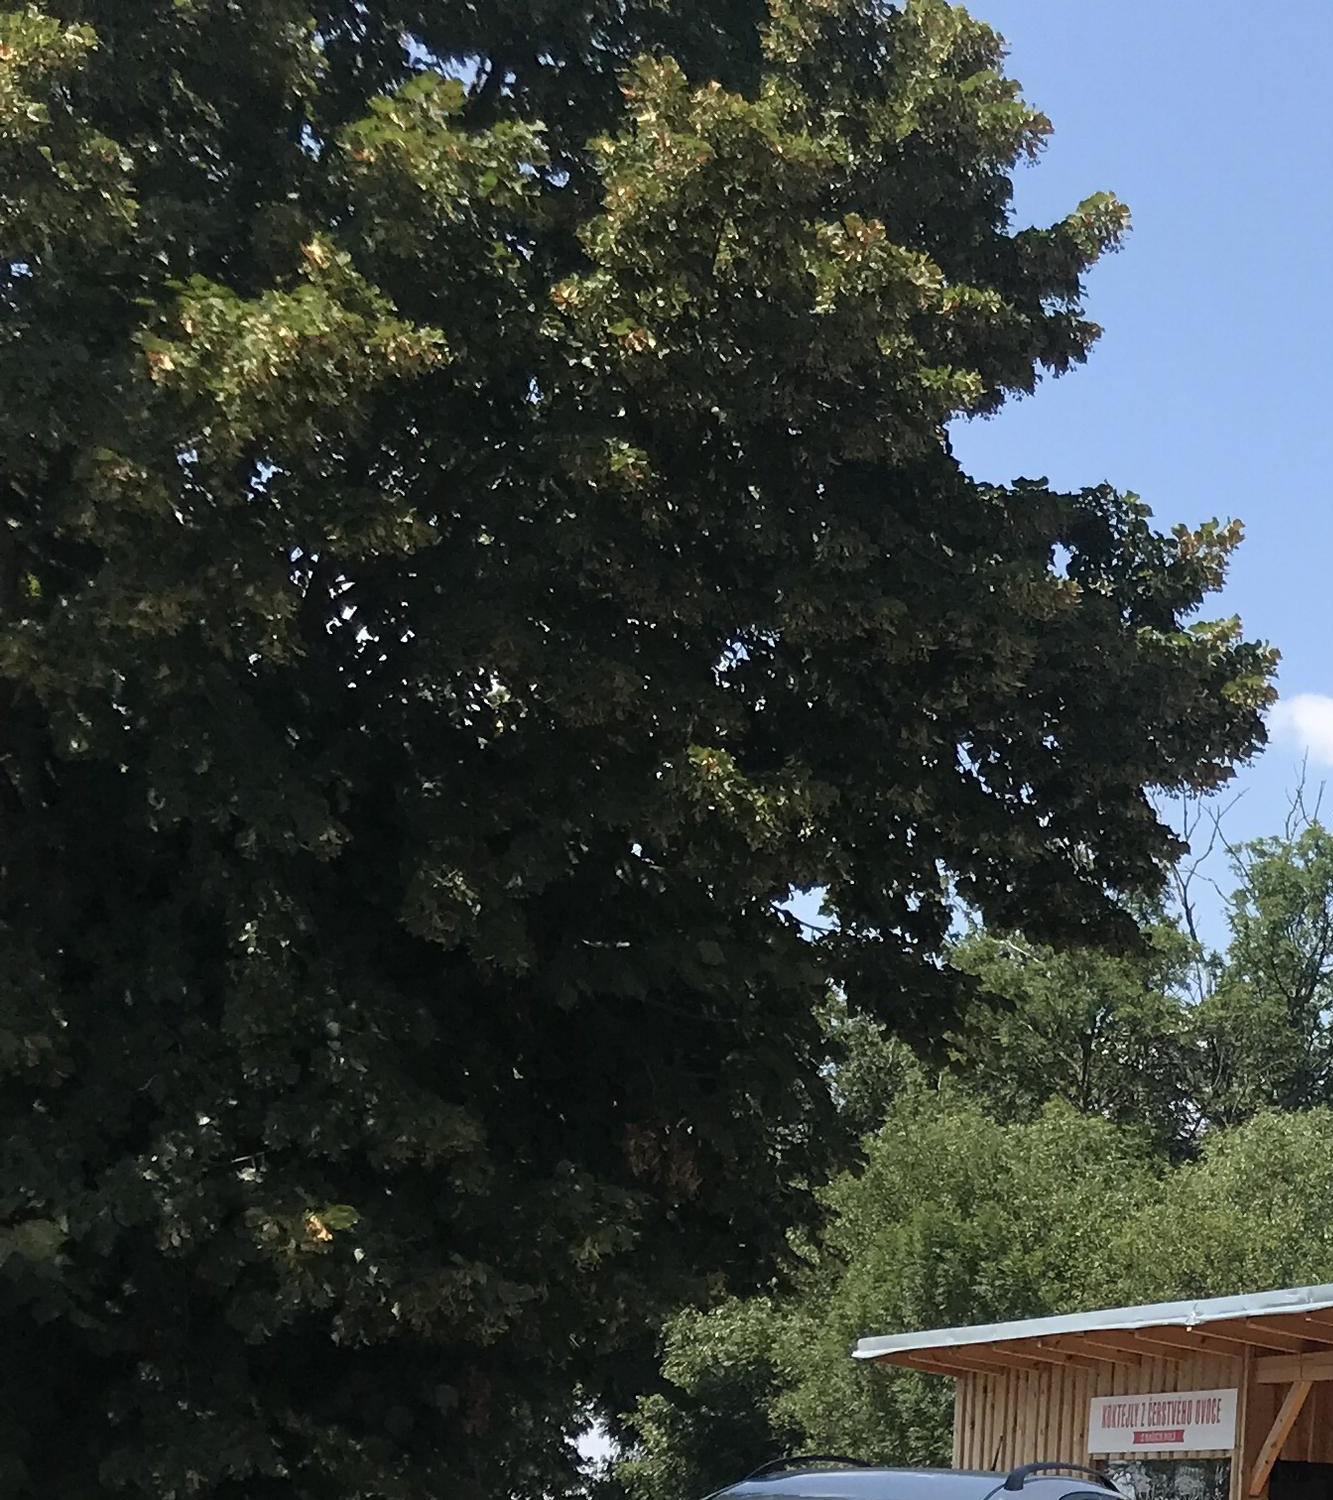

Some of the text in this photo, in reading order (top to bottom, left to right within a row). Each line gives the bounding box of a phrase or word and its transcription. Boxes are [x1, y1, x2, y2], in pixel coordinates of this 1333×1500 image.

[1102, 1397, 1222, 1428] KOKTEJLY Z ČERSTVÉHO OVOCE
